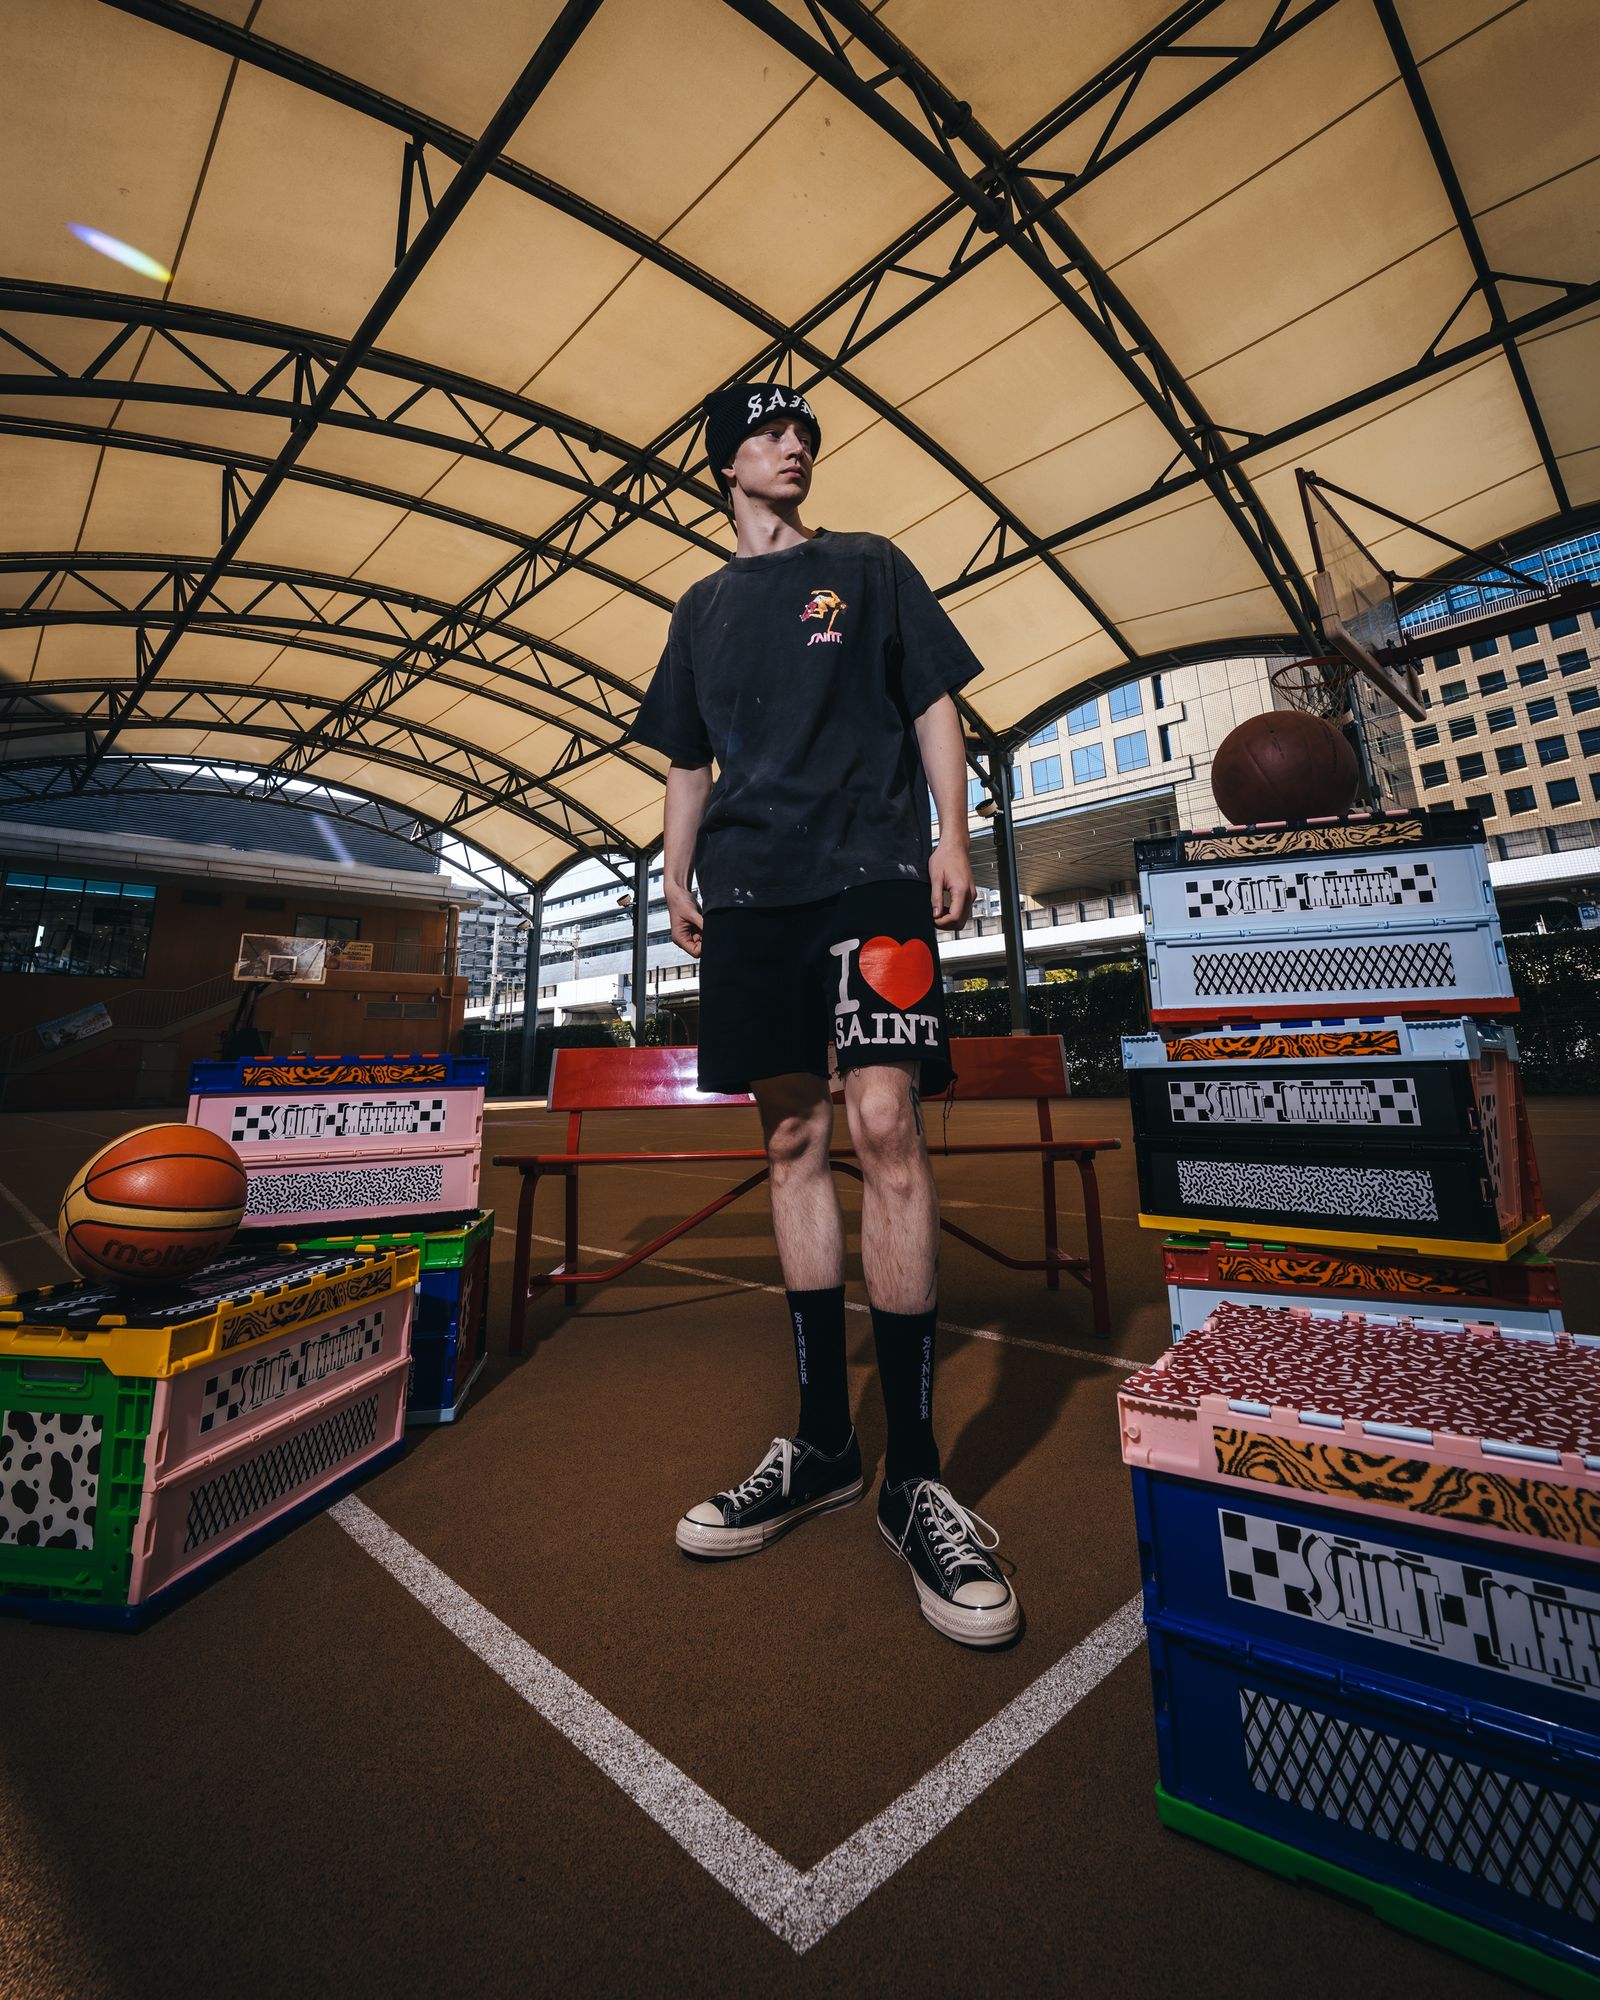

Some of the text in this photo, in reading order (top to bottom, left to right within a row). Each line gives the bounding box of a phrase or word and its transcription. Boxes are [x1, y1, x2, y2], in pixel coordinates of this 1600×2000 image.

[1224, 879, 1288, 915] SAINT
[829, 938, 860, 1016] I
[835, 1013, 939, 1050] SAINT
[1205, 1083, 1265, 1121] SAINT
[268, 1106, 329, 1139] SAINT
[794, 1311, 809, 1385] SINNER
[1301, 1533, 1446, 1646] SAINT
